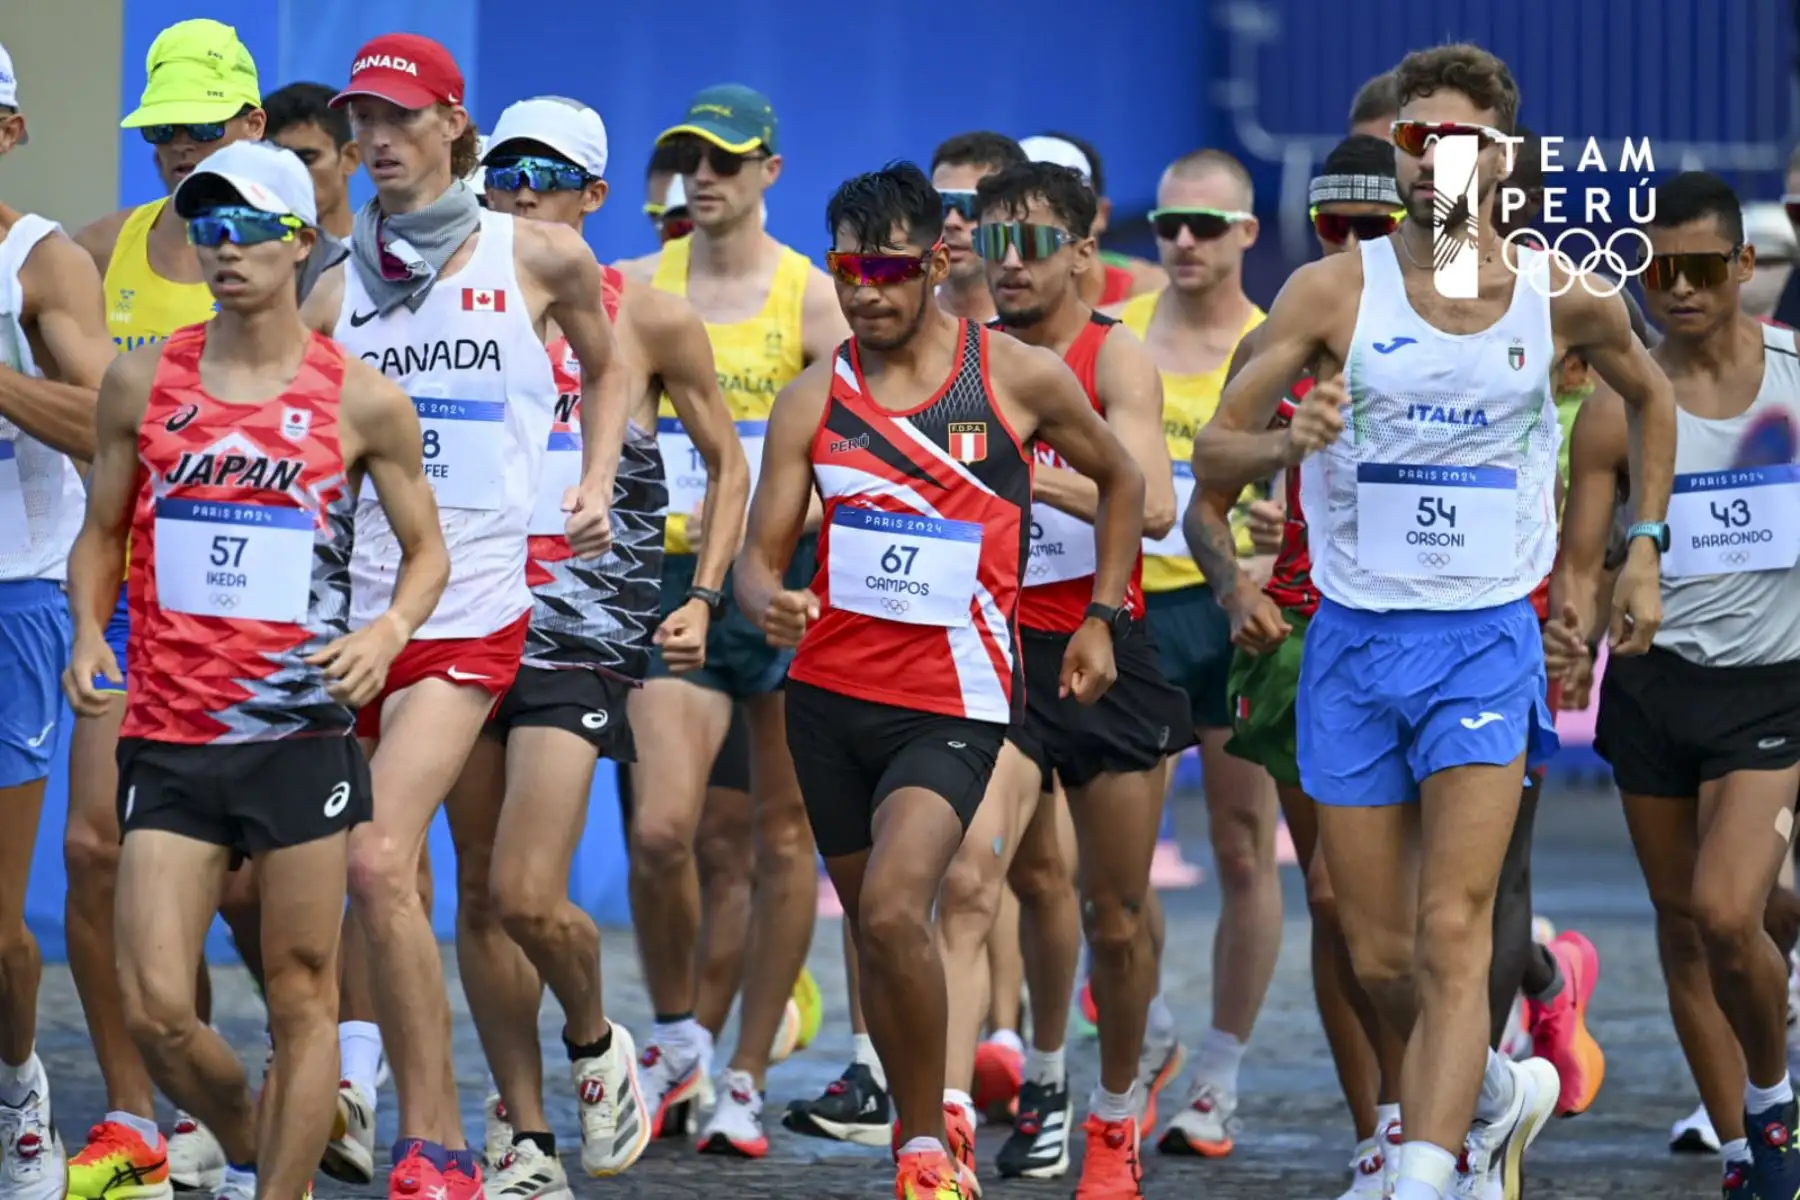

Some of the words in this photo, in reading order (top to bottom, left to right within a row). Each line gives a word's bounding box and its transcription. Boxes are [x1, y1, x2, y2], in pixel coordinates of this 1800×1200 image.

[352, 54, 418, 77] CANADA
[430, 403, 466, 415] 2024
[1407, 403, 1489, 427] ITALIA
[422, 429, 441, 459] 8
[830, 432, 870, 454] PERÚ
[165, 453, 303, 491] JAPAN
[421, 463, 449, 479] FEE
[1398, 469, 1437, 481] PARIS
[1441, 471, 1477, 483] 2024
[1690, 475, 1728, 488] PARIS
[1731, 471, 1765, 484] 2024
[192, 505, 231, 519] PARIS
[234, 508, 273, 522] 2024
[1415, 496, 1457, 529] 54
[1709, 498, 1752, 529] 43
[865, 515, 903, 529] PARIS
[907, 520, 943, 534] 2024
[1029, 542, 1066, 558] KMAZ
[1405, 530, 1466, 548] ORSONI
[1691, 528, 1774, 550] BARRONDO
[209, 535, 250, 568] 57
[880, 544, 921, 576] 67
[206, 571, 248, 588] IKEDA
[865, 575, 931, 597] CAMPOS
